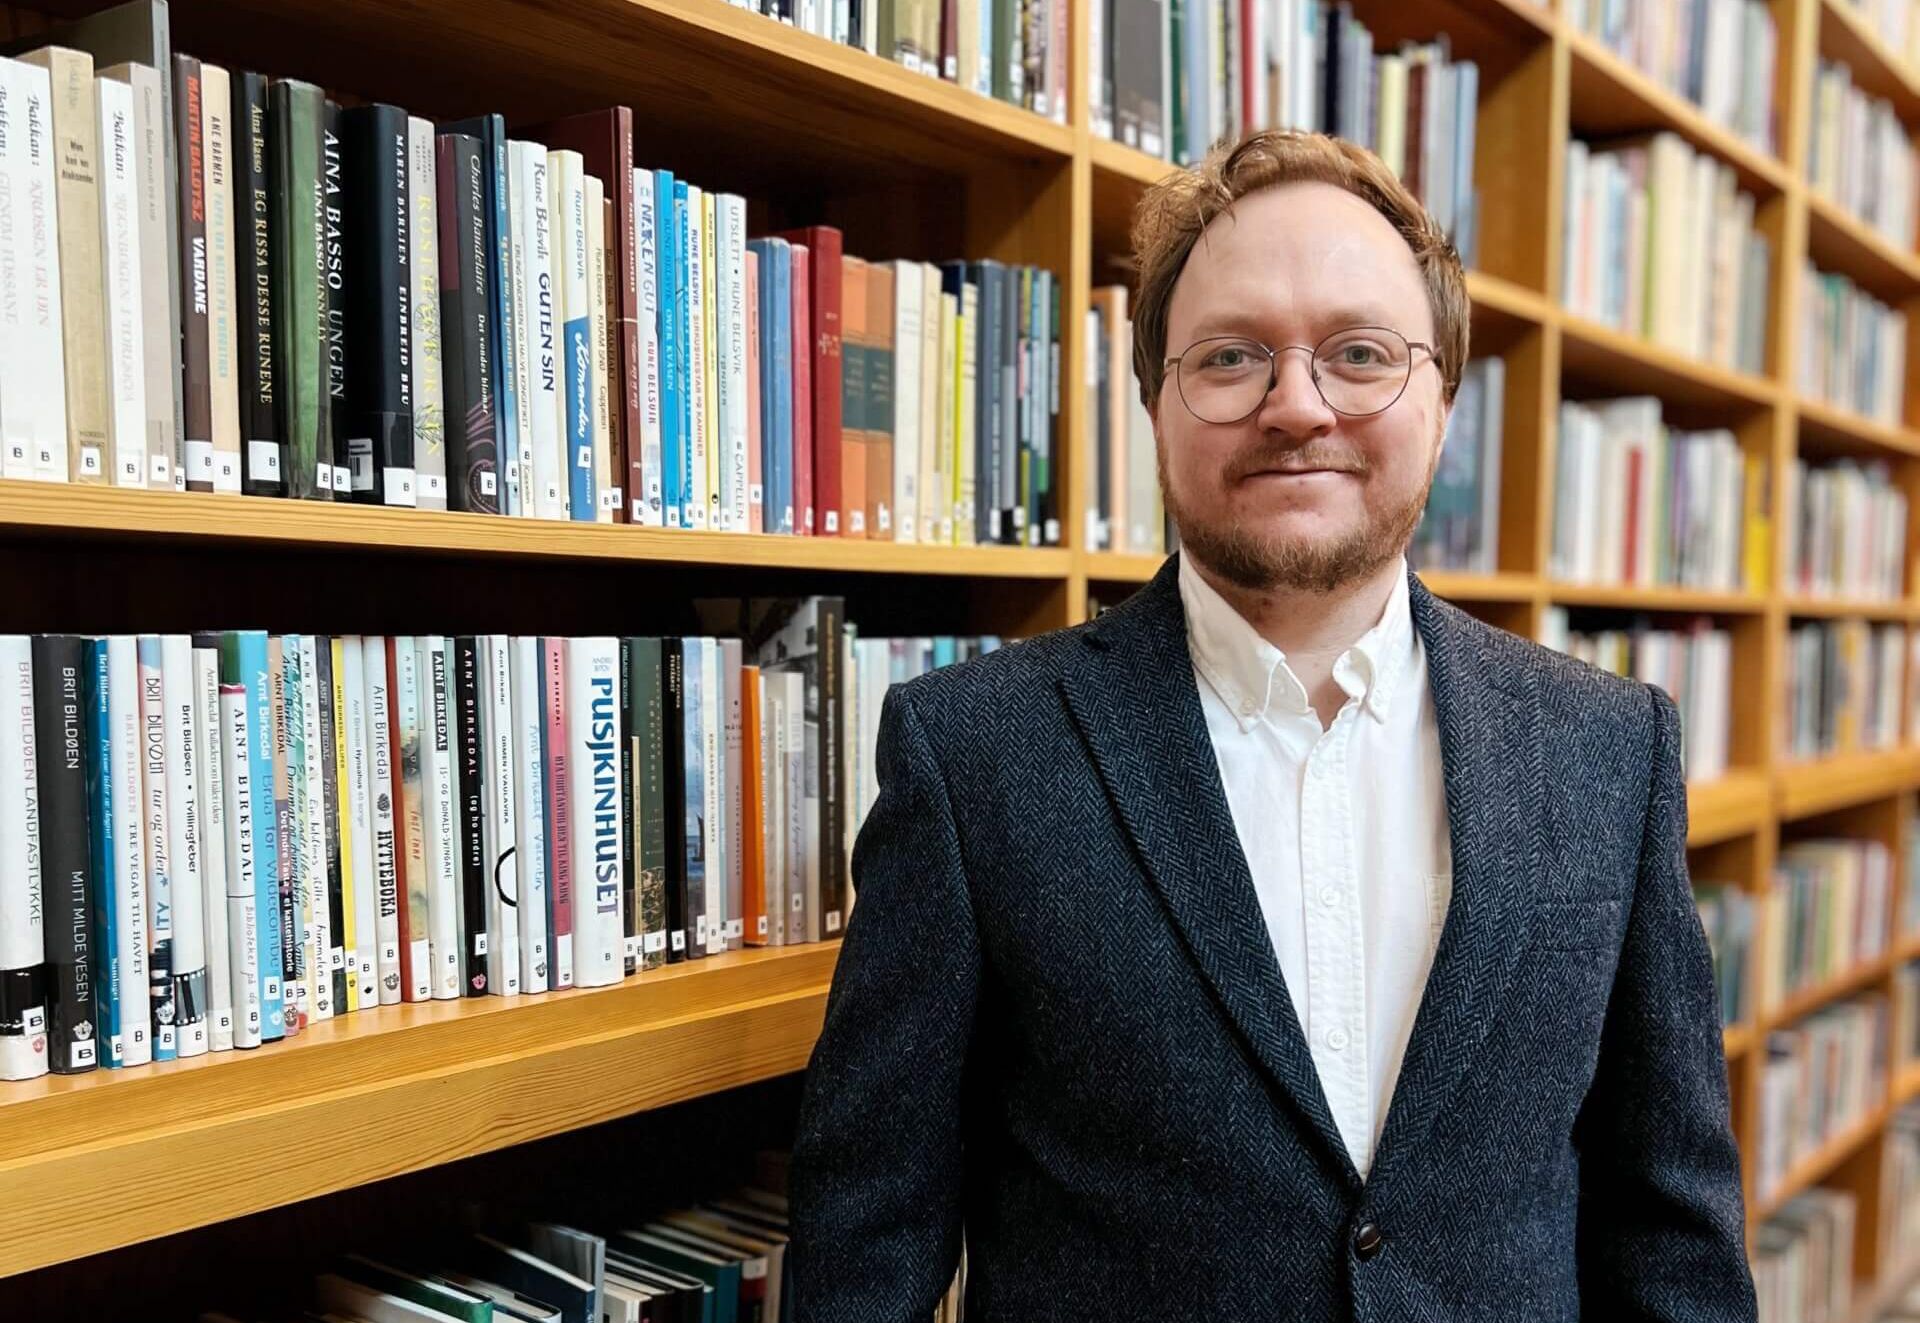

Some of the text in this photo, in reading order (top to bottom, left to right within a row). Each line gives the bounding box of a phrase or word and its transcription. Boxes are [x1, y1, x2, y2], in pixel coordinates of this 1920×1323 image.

[211, 115, 223, 186] ANE BARMEN
[187, 76, 207, 315] MARTIN VARDANE
[470, 154, 482, 211] Charles
[313, 179, 325, 271] AINA BASSO
[574, 189, 586, 281] Rune Belsvik
[251, 104, 273, 404] Aina Basso EG RISSA DESSE RUNENE
[324, 129, 345, 399] AINA BASSO UNGEN
[395, 134, 410, 405] MAREN BARLIEN EINBREID BRU
[471, 215, 486, 297] Baudelaire
[533, 162, 556, 392] Rune Belsvik GUTEN SIN
[641, 203, 655, 314] NAKEN GUT
[691, 229, 700, 307] RUNE BELSVIK
[730, 206, 744, 377] UTSLETT RUNE BELSVIK
[477, 314, 486, 333] Det
[664, 308, 673, 340] OVER
[206, 668, 216, 687] Arnt
[319, 679, 328, 706] ARNT
[434, 655, 444, 688] ARNT
[208, 728, 218, 763] Balladen
[321, 710, 331, 761] BIRKEDAL
[436, 691, 447, 750] BIRKEDAL
[145, 678, 166, 832] BRIT BILDØEN tur og
[464, 649, 481, 867] ARNT BIRKEDAL (og ho andre)
[18, 662, 40, 927] BRIT BILDØEN LANDFASTLYKKE
[182, 705, 198, 874] Brit Bildøen Tvillingfeber
[233, 708, 253, 882] ARNT BIRKEDAL
[286, 765, 297, 821] Draumar
[324, 802, 333, 818] alt
[373, 685, 397, 918] Arnt Birkedal HYTTEBOKA
[584, 677, 619, 919] PUSJKINHUSET
[63, 667, 89, 1002] BRIT BILDØEN MITT MILDE VESEN
[128, 821, 138, 848] TRE
[256, 671, 281, 968] Arnt Birkedal Brua før Widecombe
[273, 672, 295, 973] ARNT BIRKEDAL Det Indre Tasta ei kattehistorie
[130, 853, 140, 899] VEGAR
[132, 903, 141, 927] TIL
[244, 905, 256, 967] biblioteket
[133, 931, 142, 976] HAVET
[315, 924, 327, 977] himmelen
[333, 955, 340, 964] B
[349, 958, 354, 966] B
[363, 964, 369, 972] B
[387, 949, 394, 958] B
[449, 955, 455, 963] B
[240, 972, 255, 985] på
[270, 985, 276, 993] B
[286, 989, 293, 998] B
[318, 985, 325, 993] B
[30, 1016, 43, 1027] B
[135, 1031, 143, 1042] B
[163, 1033, 171, 1042] B
[196, 1031, 201, 1040] B
[221, 1017, 229, 1026] B
[251, 1012, 257, 1021] B
[78, 1049, 93, 1059] B
